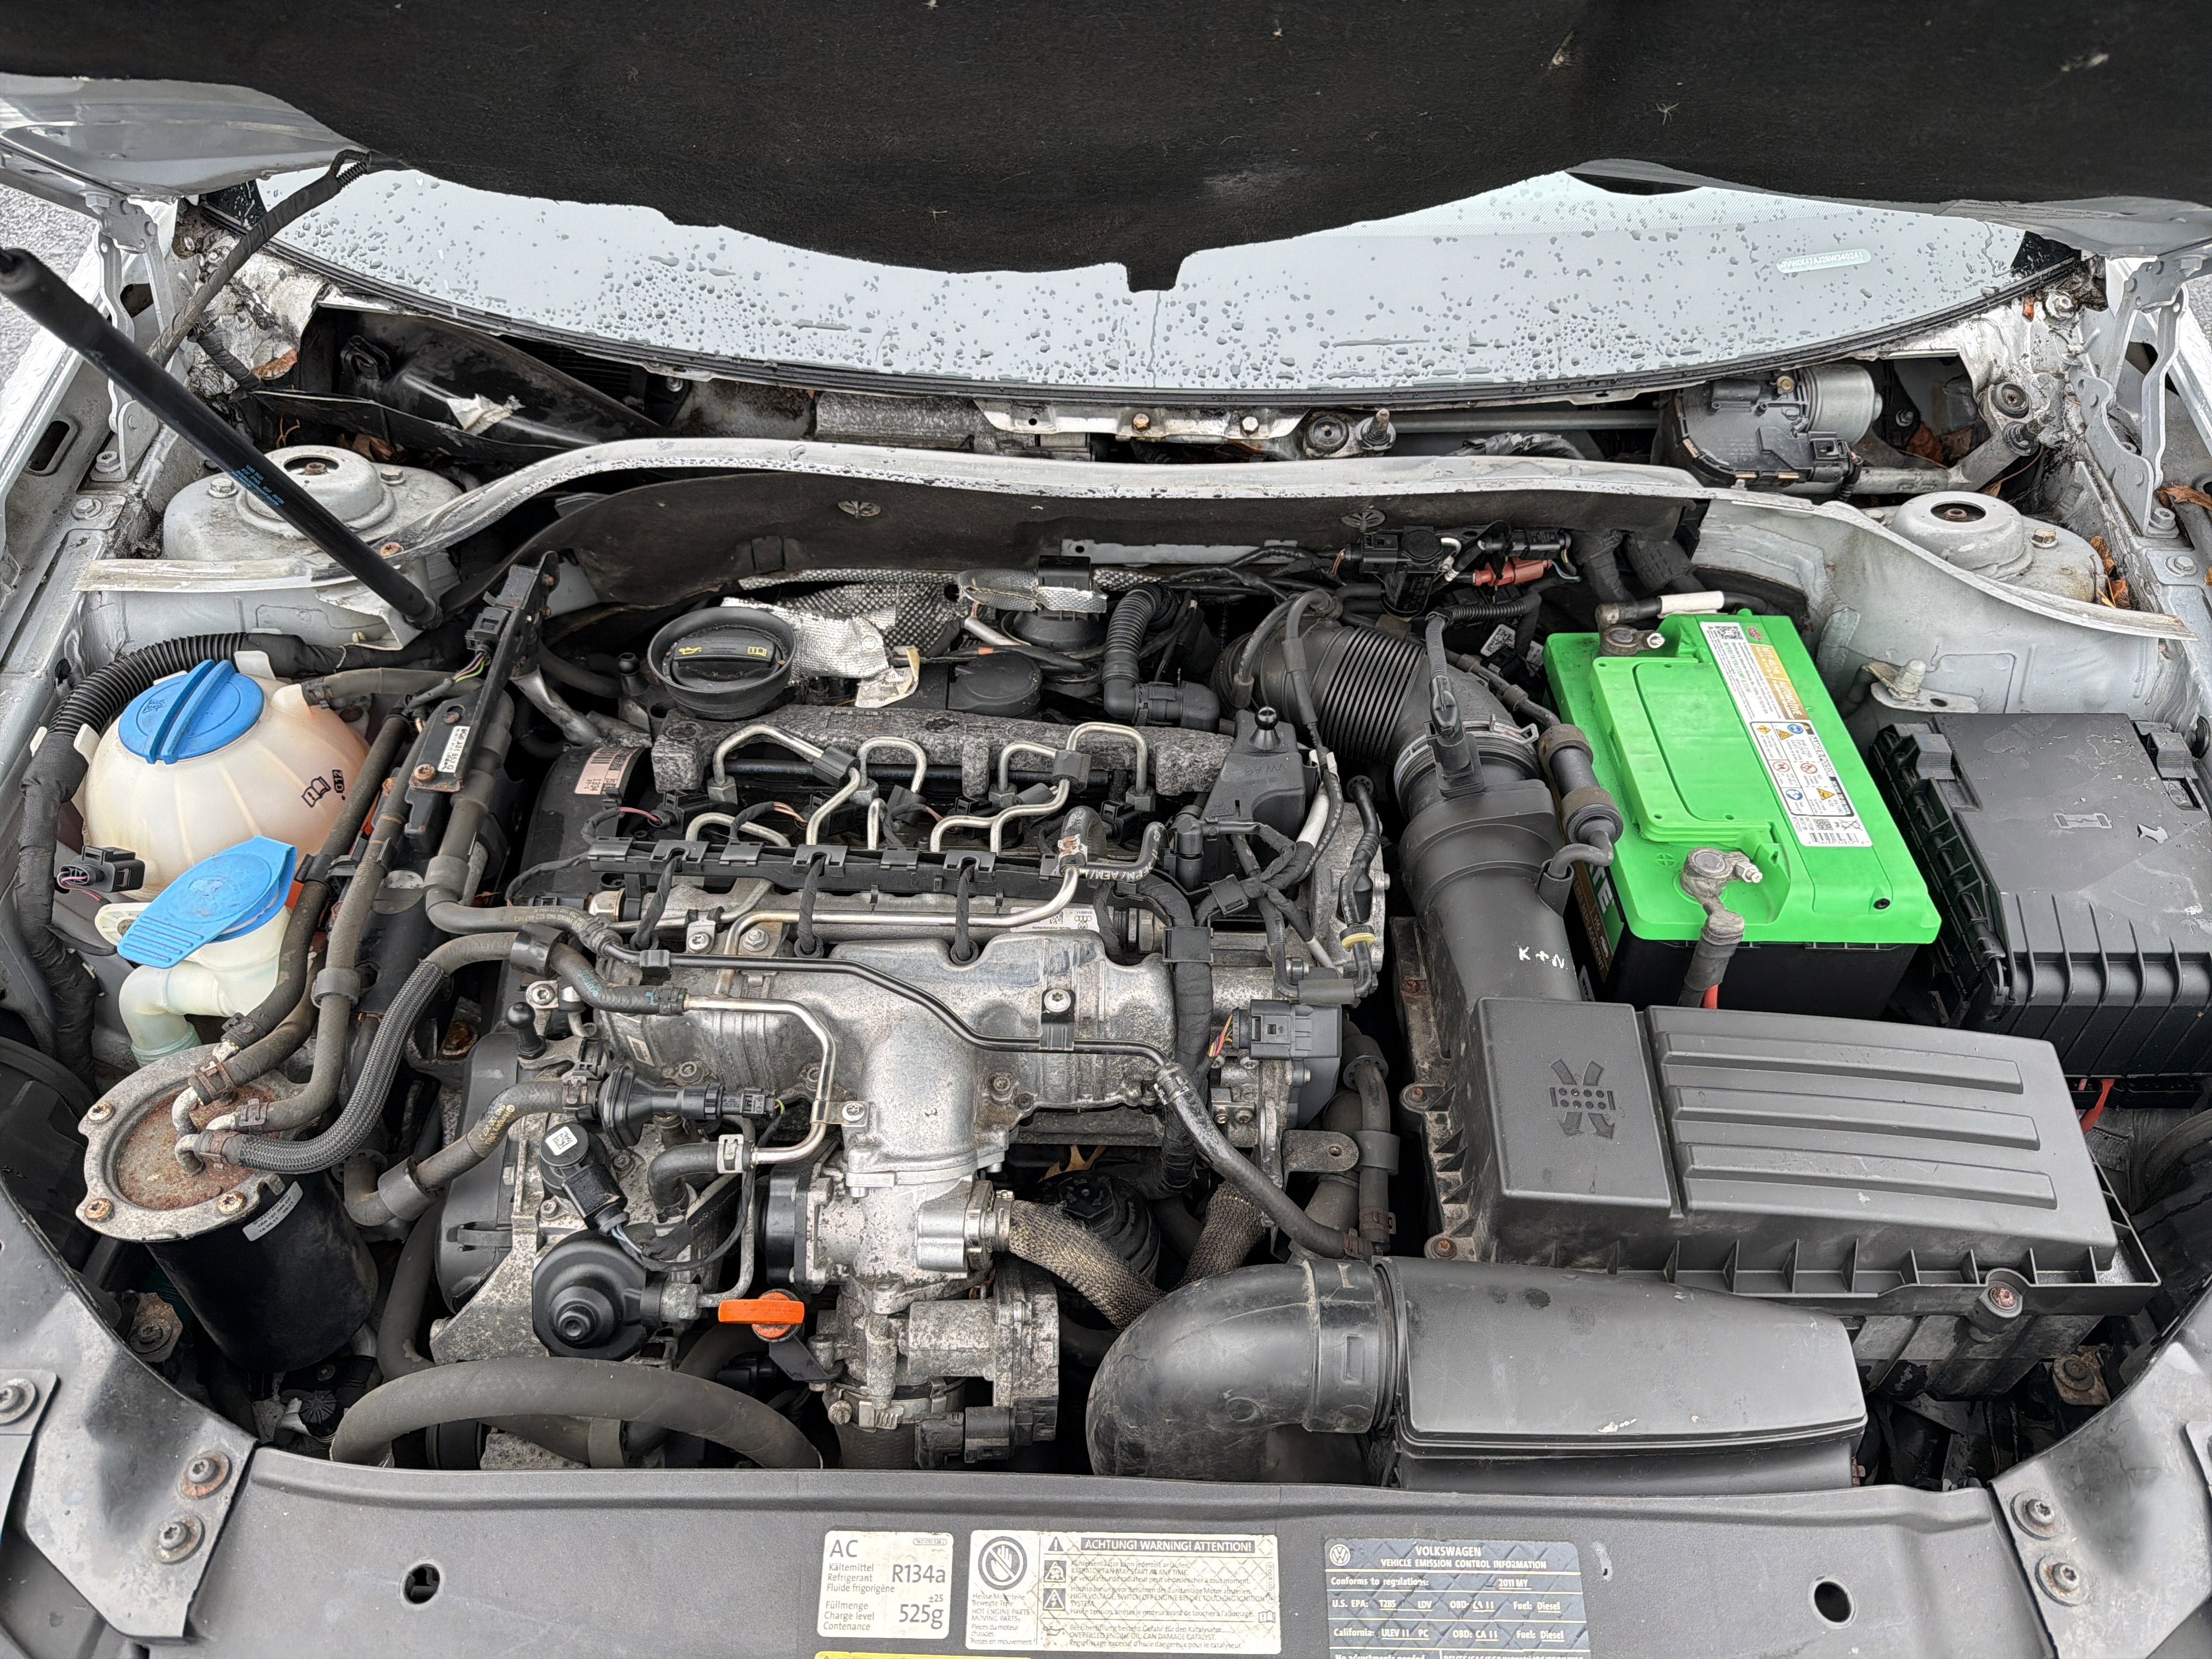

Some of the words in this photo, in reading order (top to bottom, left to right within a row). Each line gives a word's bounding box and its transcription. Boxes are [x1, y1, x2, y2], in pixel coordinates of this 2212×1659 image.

[830, 1539, 858, 1558] AC
[1085, 1539, 1137, 1550] ACHTUNG!
[1140, 1541, 1192, 1551] WARNING!
[1194, 1541, 1251, 1552] ATTENTION!
[1415, 1546, 1481, 1557] VOLKSWAGEN
[1381, 1559, 1412, 1567] VEHICLE
[1415, 1560, 1452, 1568] EMISSION
[1455, 1560, 1491, 1568] CONTROL
[1493, 1560, 1547, 1569] INFORMATION
[828, 1573, 872, 1584] Refrigerant
[892, 1564, 945, 1583] R134a
[1331, 1577, 1368, 1585] Conforms
[1370, 1577, 1379, 1585] to
[1383, 1577, 1429, 1587] regulations:
[1516, 1579, 1528, 1588] MY
[827, 1584, 850, 1592] Fluide
[853, 1584, 895, 1594] frigorigène
[1332, 1600, 1348, 1608] U.S.
[1351, 1600, 1369, 1609] EPA:
[1513, 1601, 1532, 1610] Fuel:
[1537, 1602, 1560, 1611] Diesel
[825, 1612, 853, 1622] Charge
[856, 1612, 874, 1620] level
[826, 1601, 868, 1611] Füllmenge
[899, 1604, 944, 1629] 525g
[823, 1622, 871, 1630] Contenance
[1334, 1628, 1375, 1637] California:
[1381, 1629, 1400, 1638] ULEV
[1418, 1629, 1429, 1638] PC
[1453, 1630, 1472, 1639] OBD:
[1475, 1630, 1487, 1639] CA
[1516, 1630, 1536, 1639] Fuel:
[1541, 1630, 1564, 1639] Diesel
